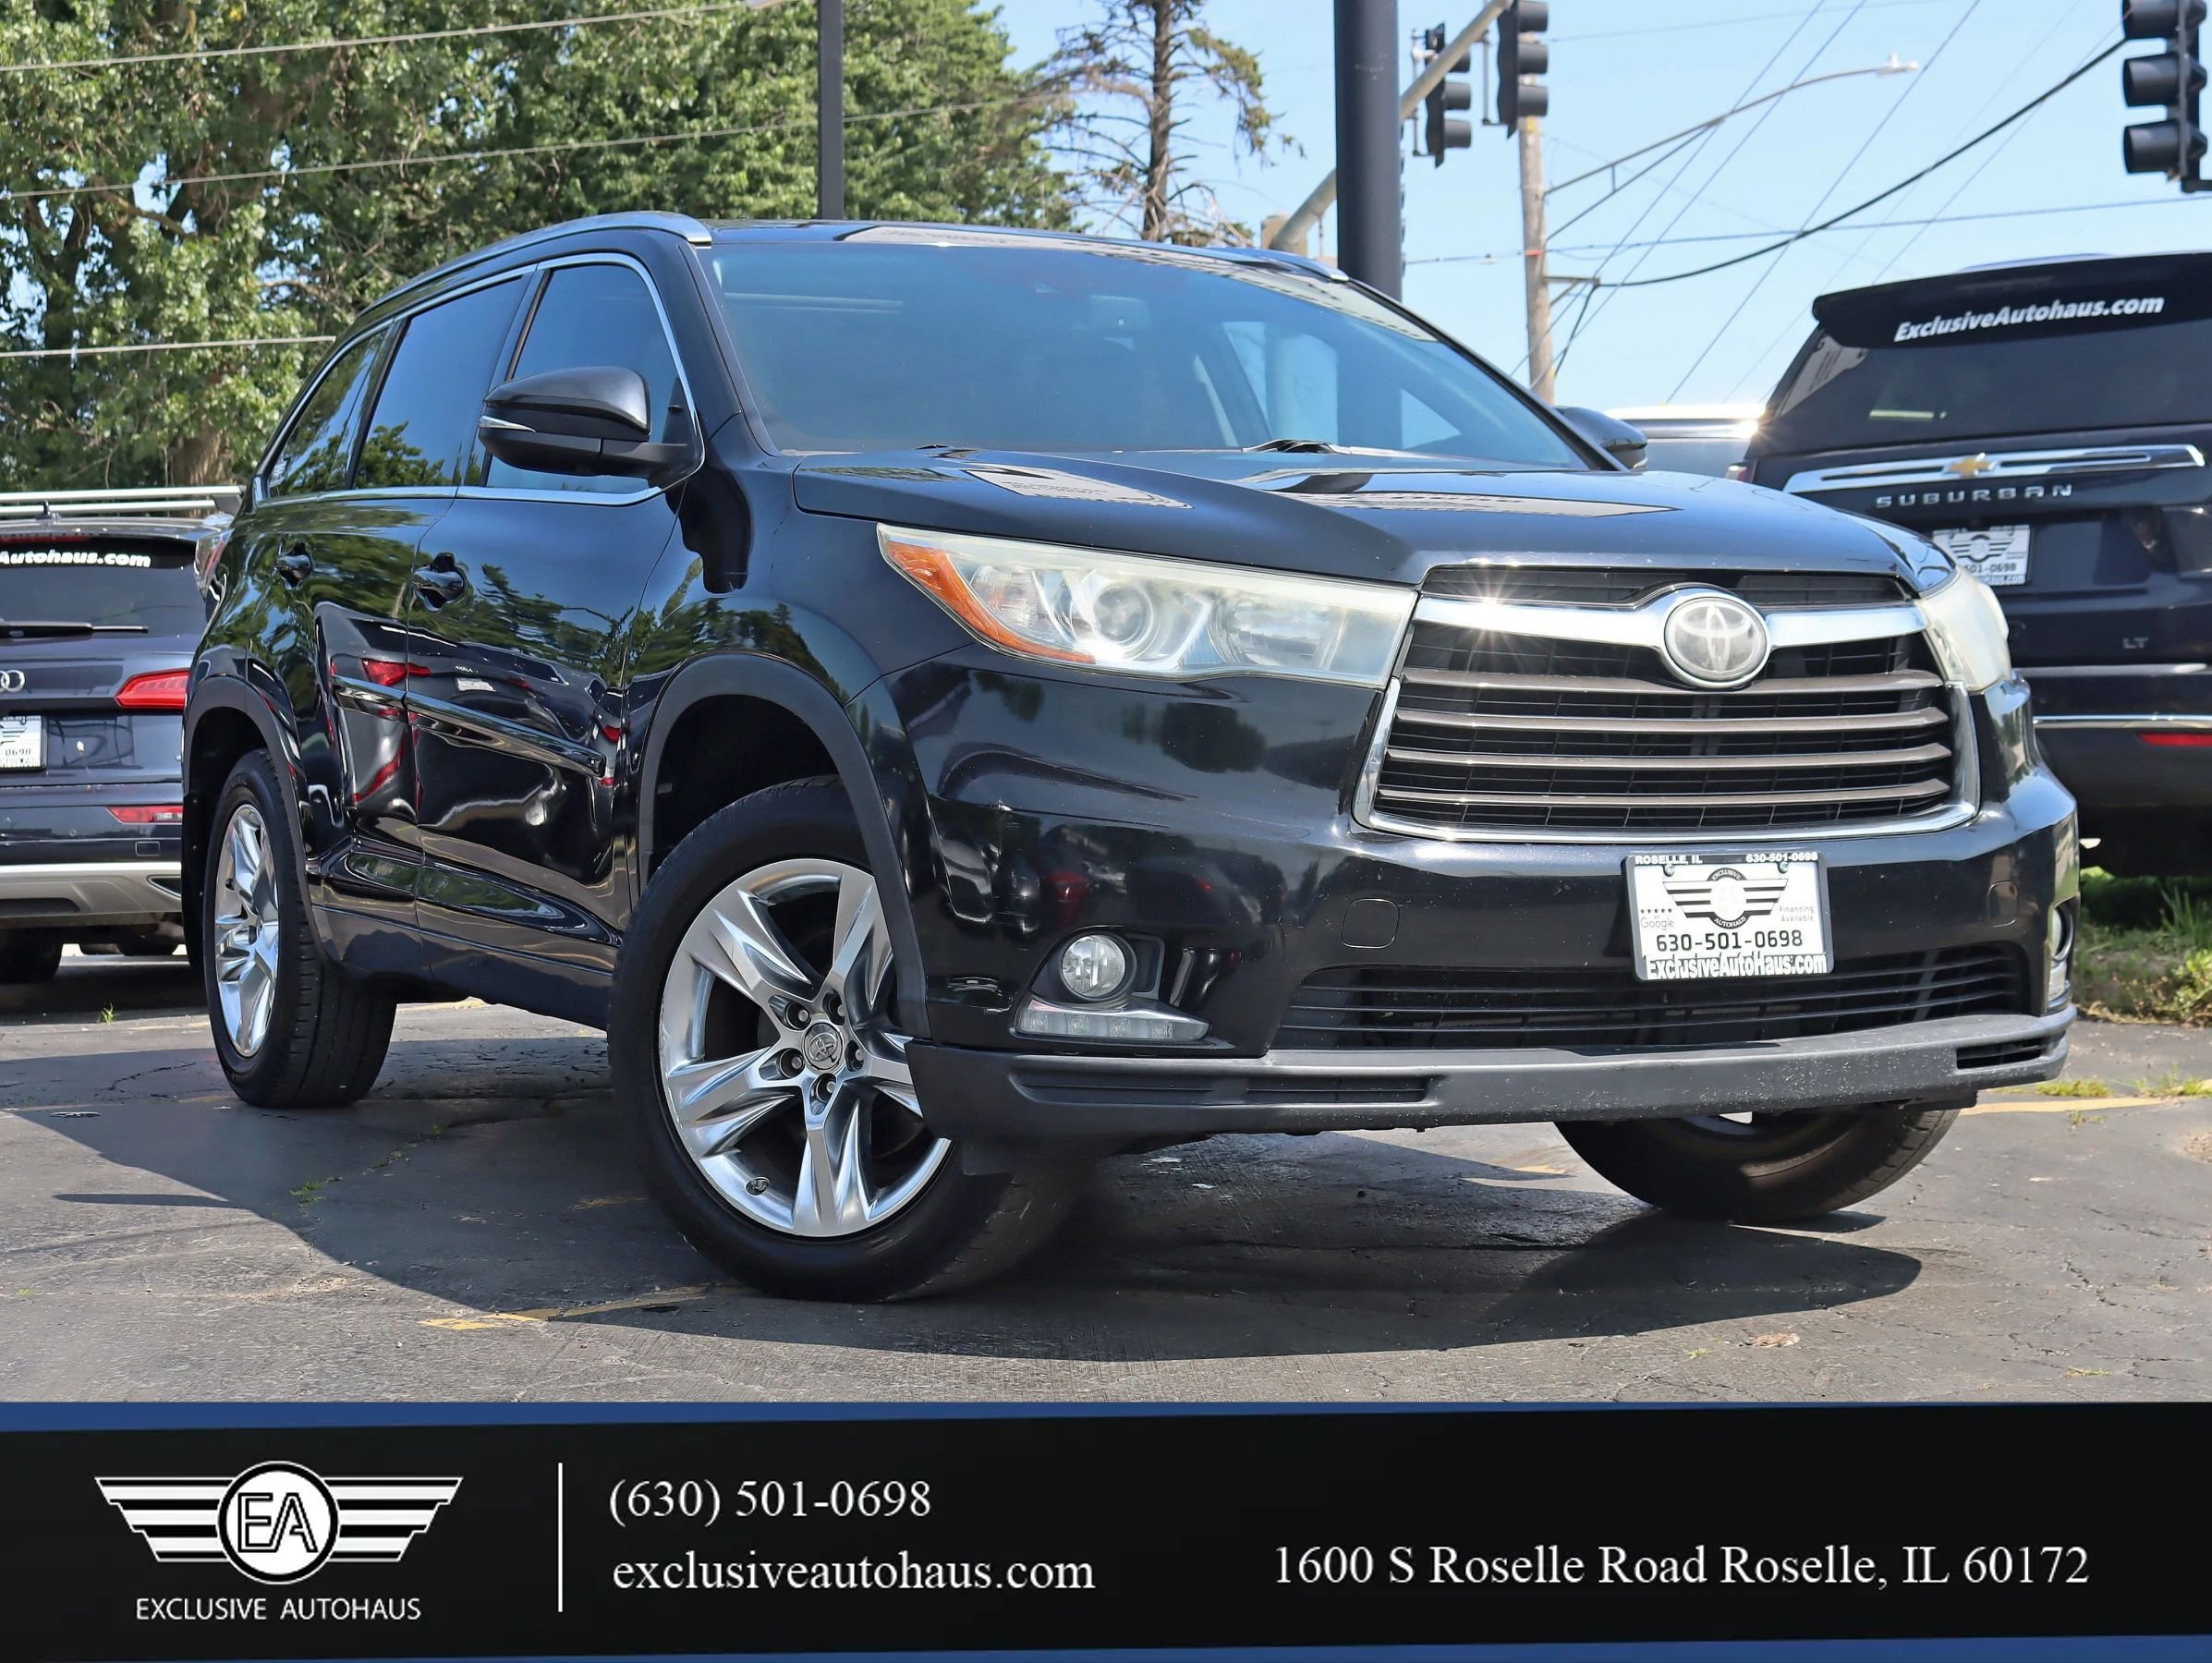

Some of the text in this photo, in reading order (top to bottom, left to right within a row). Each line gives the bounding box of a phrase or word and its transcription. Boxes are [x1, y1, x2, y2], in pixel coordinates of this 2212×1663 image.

[1894, 297, 2165, 342] ExclusiveAutohaus.com
[1877, 484, 2072, 508] SUBURBAN
[2122, 637, 2149, 649] LT
[1635, 855, 1703, 866] ROSELLE, IL
[1745, 852, 1818, 863] 630-501-0698
[1711, 868, 1742, 881] EXCLUSIVE
[1640, 916, 1674, 930] Google
[1713, 916, 1747, 929] AUTOHAUS
[1656, 929, 1804, 953] 630-501-0698
